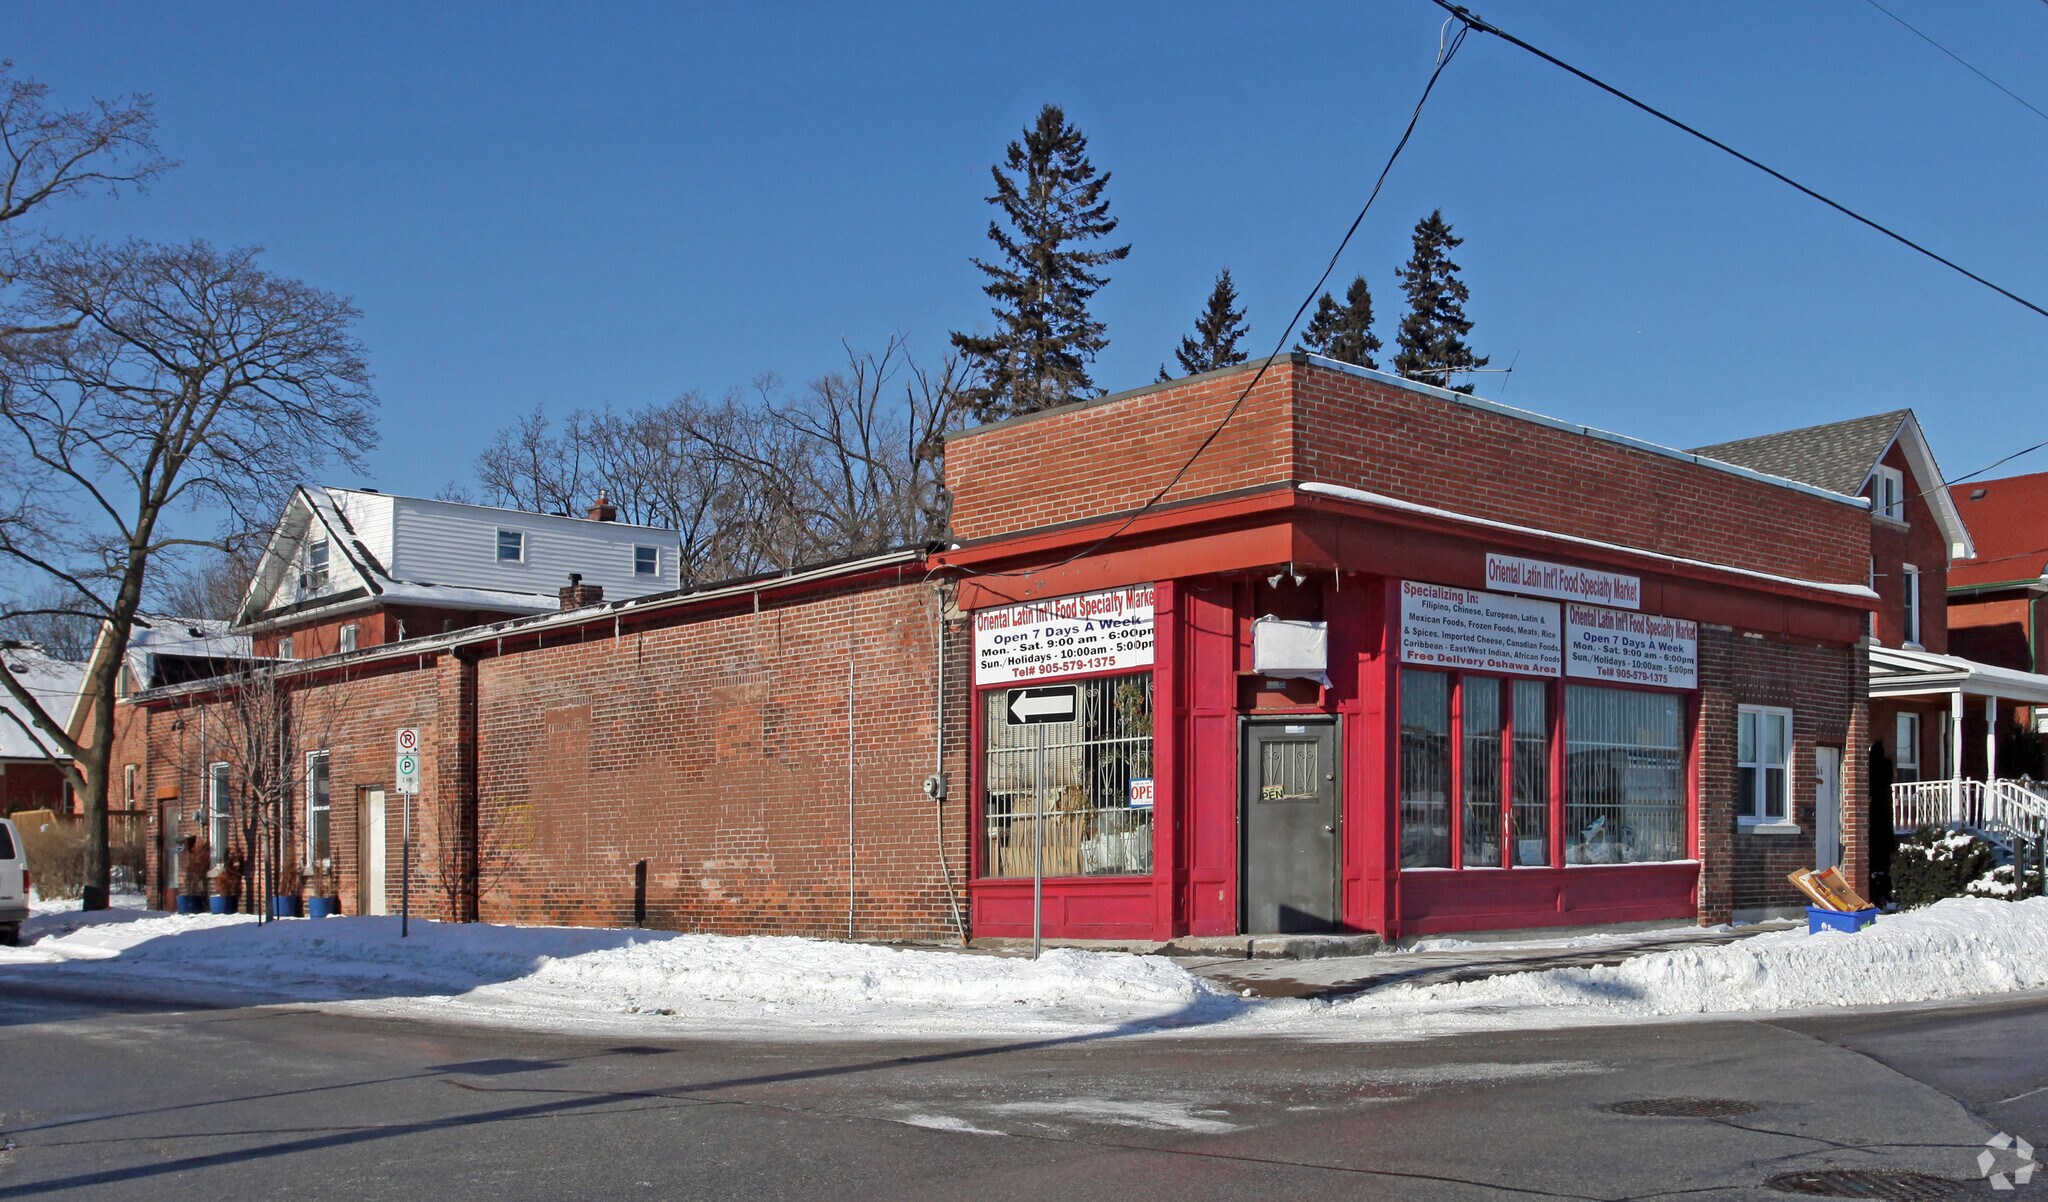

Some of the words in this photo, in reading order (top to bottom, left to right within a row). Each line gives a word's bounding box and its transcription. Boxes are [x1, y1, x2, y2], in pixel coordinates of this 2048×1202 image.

[1488, 558, 1520, 584] Oriental
[1522, 564, 1541, 588] Latin
[1559, 568, 1578, 592] Food
[1580, 572, 1612, 603] Specialty
[1614, 578, 1637, 602] Market
[1404, 582, 1463, 604] Specializing
[1466, 592, 1478, 604] In:
[978, 608, 1009, 632] Oriental
[1012, 605, 1033, 626] Latin
[1056, 597, 1077, 620] Food
[1080, 592, 1123, 621] Specialty
[1126, 586, 1154, 610] Marke
[1421, 600, 1451, 612] Filipino,
[1453, 604, 1483, 617] Chinese,
[1486, 609, 1520, 621] European,
[1522, 614, 1538, 622] Latin
[1540, 616, 1545, 624] &
[994, 633, 1028, 645] Open
[1033, 629, 1040, 639] 7
[1046, 626, 1079, 637] Days
[1085, 622, 1094, 632] A
[1099, 616, 1142, 630] Week
[1409, 612, 1440, 624] Mexican
[1442, 617, 1466, 629] Foods,
[1468, 620, 1492, 630] Frozen
[1494, 624, 1516, 634] Foods,
[1518, 627, 1540, 638] Meats,
[1542, 630, 1556, 639] Rice
[1570, 605, 1596, 628] Oriental
[1598, 610, 1614, 630] Latin
[1630, 614, 1644, 634] Food
[1646, 617, 1674, 642] Specialty
[1676, 621, 1695, 641] Market
[982, 648, 1009, 657] Mon.
[1020, 642, 1043, 652] Sat.
[1047, 637, 1074, 648] 9:00
[1078, 636, 1097, 644] am
[1404, 626, 1410, 634] &
[1442, 631, 1474, 641] Imported
[1507, 639, 1537, 649] Canadian
[1583, 632, 1610, 643] Open
[1613, 636, 1618, 644] 7
[1622, 637, 1645, 649] Days
[1649, 641, 1655, 649] A
[1658, 642, 1684, 653] Week
[1061, 646, 1106, 659] 10:00am
[1404, 639, 1443, 650] Caribbean
[1514, 652, 1538, 660] African
[1573, 641, 1596, 651] Mon.
[1603, 645, 1620, 654] Sat.
[1623, 648, 1641, 657] 9:00
[1664, 654, 1694, 664] 6:00pm
[1012, 666, 1035, 678] Tel#
[1039, 656, 1116, 674] 905-579-1375
[1407, 650, 1434, 661] Free
[1437, 654, 1484, 667] Delivery
[1487, 659, 1529, 670] Oshawa
[1533, 664, 1556, 673] Area
[1632, 660, 1662, 671] 10:00am
[1668, 665, 1694, 675] 5:00pm
[1597, 666, 1614, 677] Tel#
[1616, 668, 1668, 683] 905-579-1375
[404, 761, 411, 771] P
[1131, 786, 1152, 800] OPE
[1262, 790, 1283, 800] PEN
